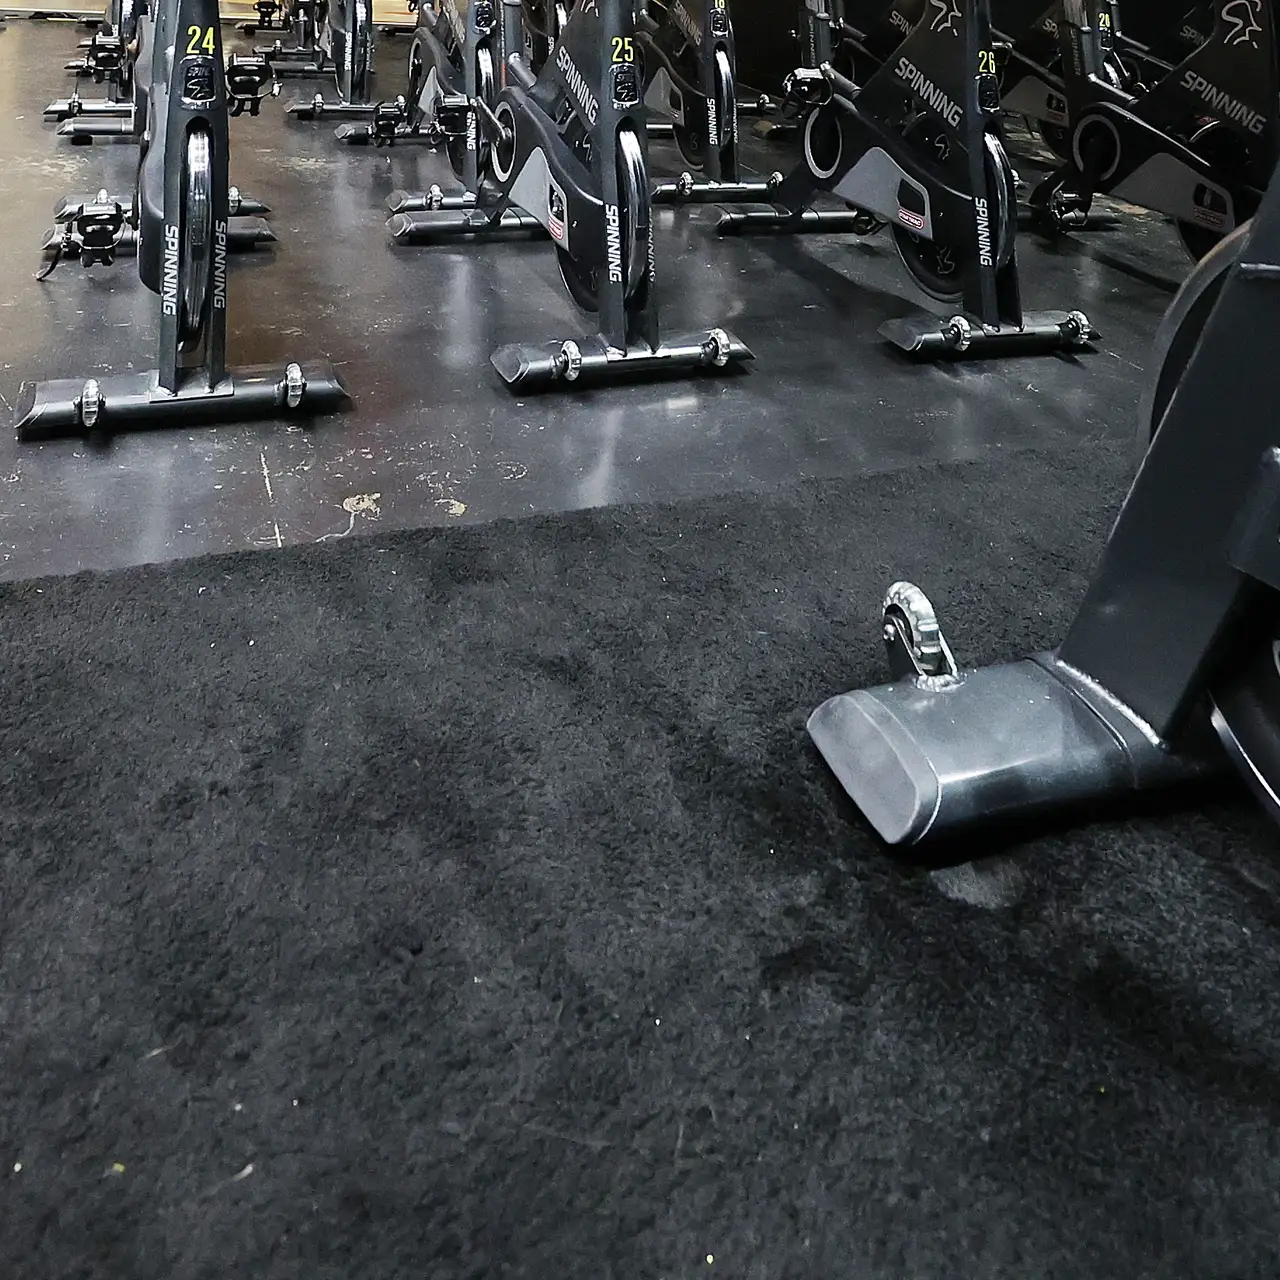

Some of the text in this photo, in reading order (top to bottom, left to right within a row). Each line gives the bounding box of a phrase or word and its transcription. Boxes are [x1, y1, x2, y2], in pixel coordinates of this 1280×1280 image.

[186, 25, 216, 55] 24
[344, 31, 353, 71] SPINNING
[611, 36, 634, 62] 25
[889, 10, 914, 36] SPIN
[556, 44, 599, 126] SPINNING
[894, 57, 964, 128] SPINNING
[978, 50, 996, 74] 26
[706, 97, 718, 146] SPINNING
[1180, 69, 1268, 135] SPINNING
[213, 219, 227, 309] SPINNING
[605, 203, 622, 283] SPINNING
[975, 197, 992, 266] SPINNING
[161, 224, 179, 316] SPINNING
